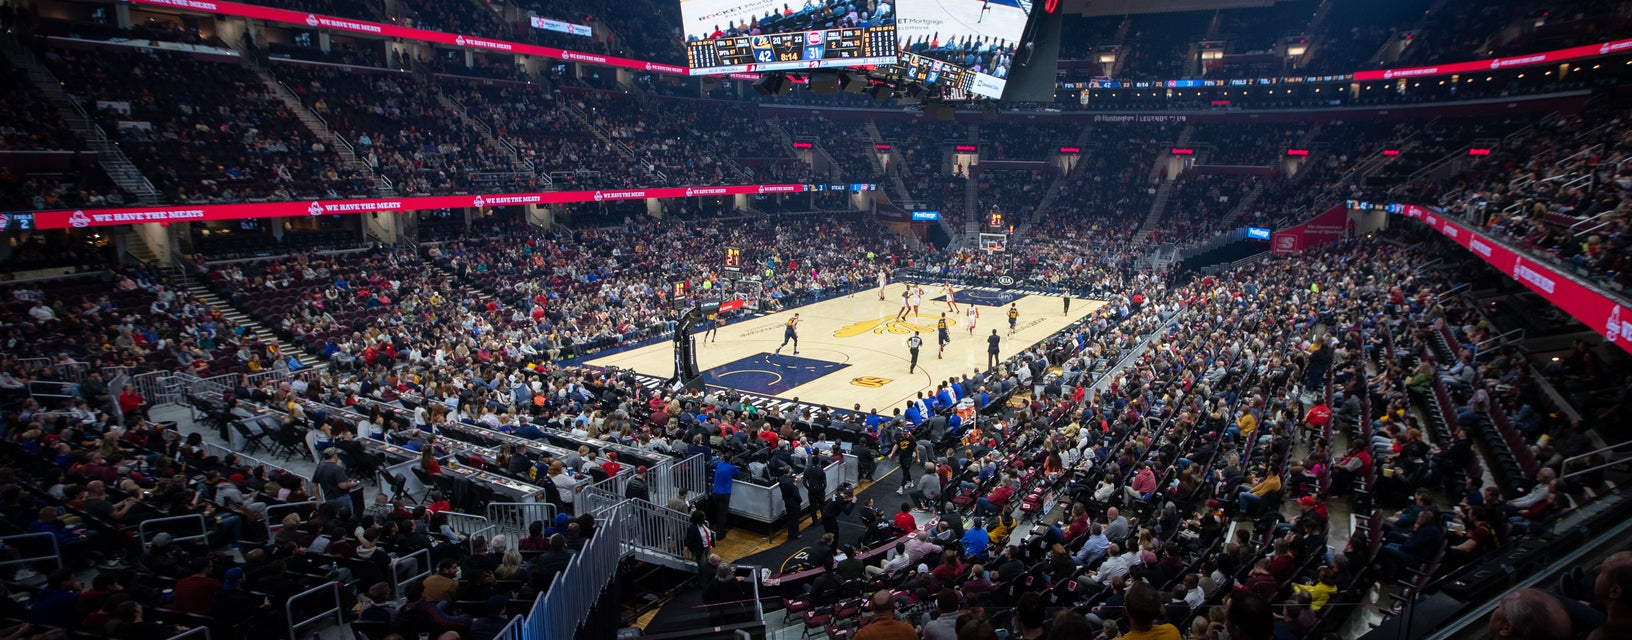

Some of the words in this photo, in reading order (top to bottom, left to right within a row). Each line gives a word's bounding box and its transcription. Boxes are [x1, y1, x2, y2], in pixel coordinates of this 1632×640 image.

[758, 51, 772, 62] 42
[780, 52, 798, 62] 8:14
[808, 48, 819, 58] 31
[93, 214, 113, 222] WE
[113, 212, 144, 221] HAVE
[144, 211, 168, 219] THE
[168, 210, 204, 218] MEATS
[21, 220, 30, 229] 2
[727, 255, 739, 266] 21
